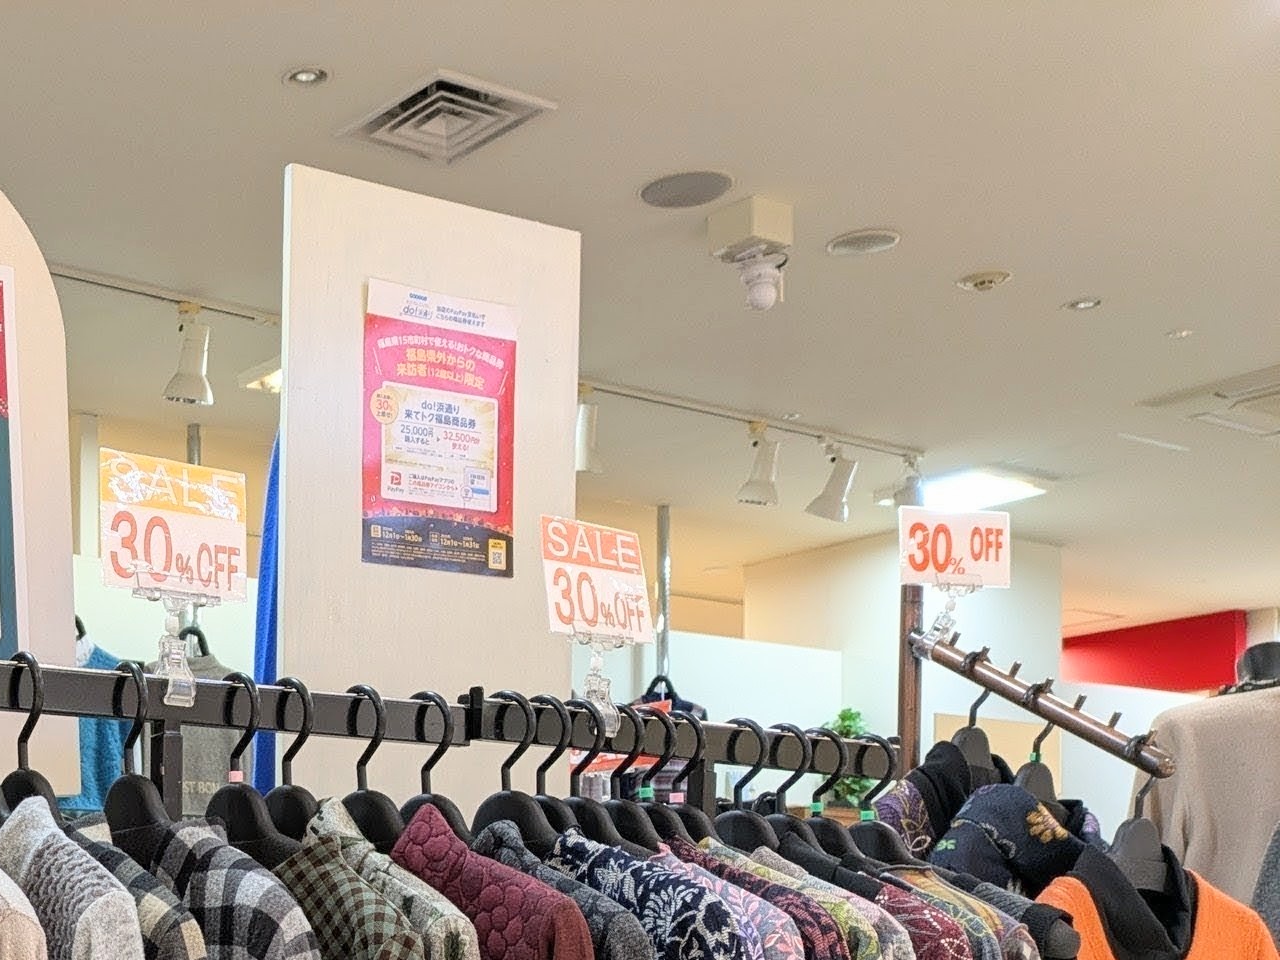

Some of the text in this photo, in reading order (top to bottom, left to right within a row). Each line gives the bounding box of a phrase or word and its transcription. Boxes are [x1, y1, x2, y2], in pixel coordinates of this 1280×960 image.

[406, 347, 476, 372] 福島県外からの
[404, 409, 476, 430] 来てトク福島商品券
[196, 542, 241, 592] OFF
[547, 519, 640, 570] SALE
[908, 522, 1004, 575] 30% OFF
[614, 591, 645, 633] OFF
